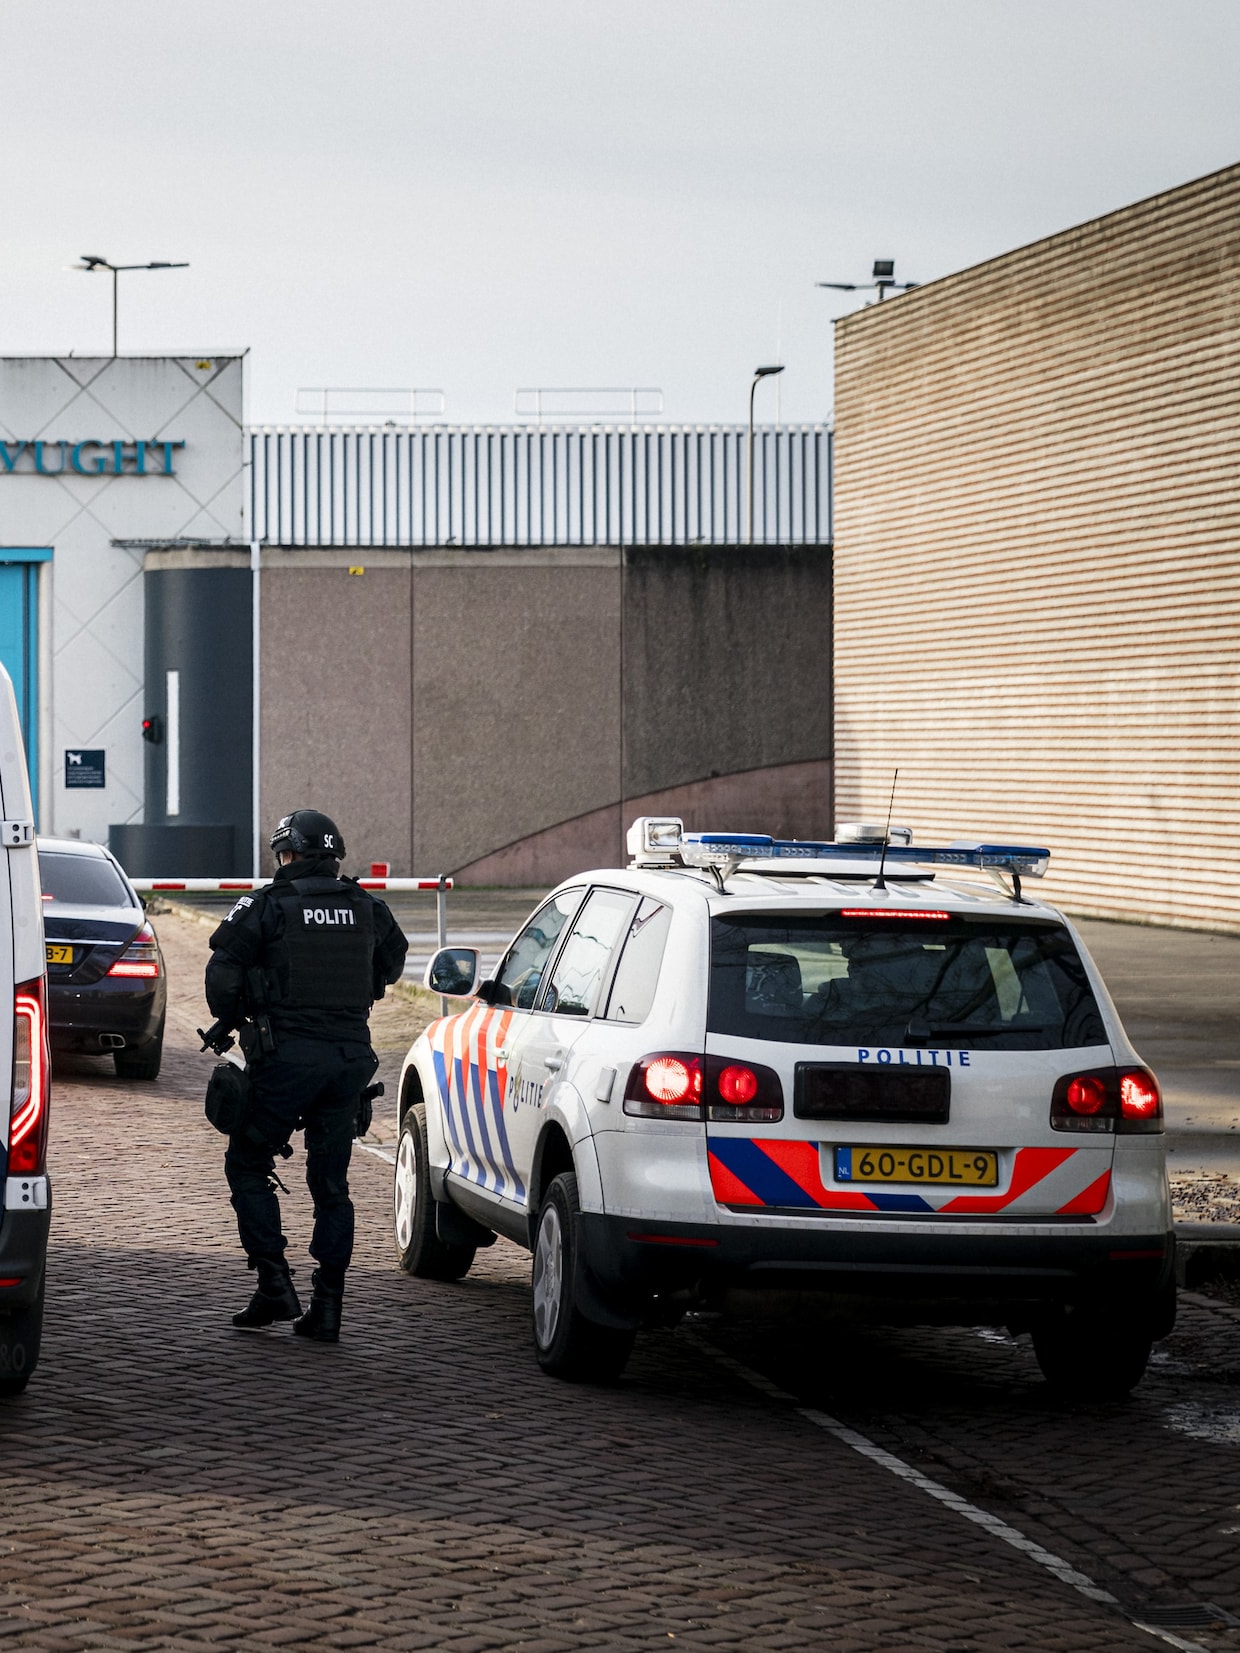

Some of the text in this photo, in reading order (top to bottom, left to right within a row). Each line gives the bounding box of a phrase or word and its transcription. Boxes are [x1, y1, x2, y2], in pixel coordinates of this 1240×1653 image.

[324, 834, 334, 849] SC
[303, 908, 357, 925] POLITI
[46, 947, 68, 961] B-7
[858, 1049, 971, 1066] POLITIE
[838, 1152, 989, 1181] NL 60-GDL-9
